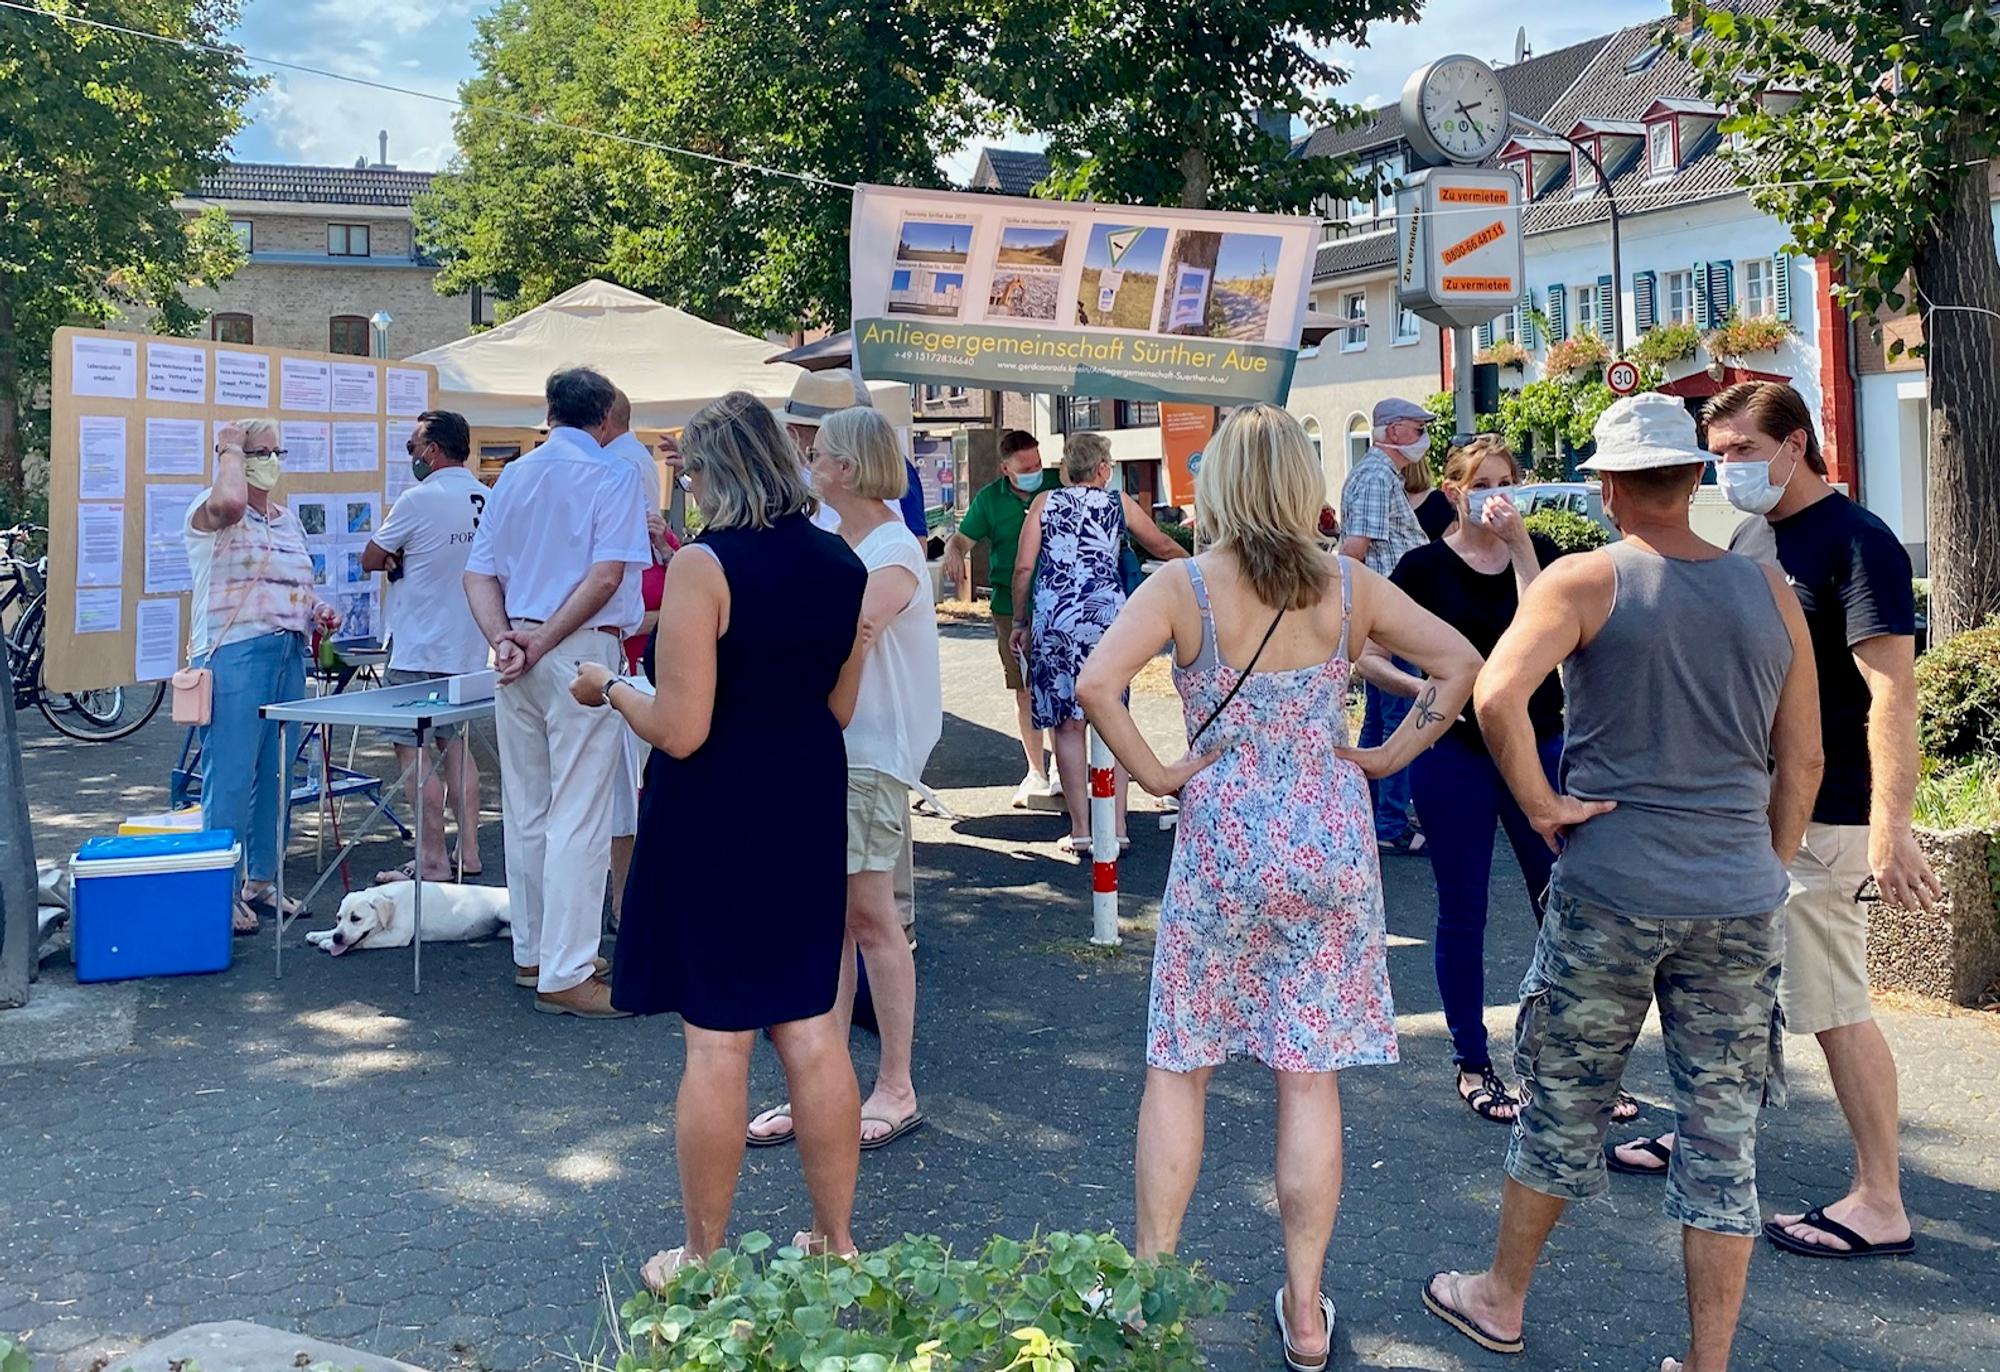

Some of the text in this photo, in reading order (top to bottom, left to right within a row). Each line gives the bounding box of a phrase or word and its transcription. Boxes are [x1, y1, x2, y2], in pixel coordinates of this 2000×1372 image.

[1442, 189, 1506, 202] Zu vermieten
[1403, 207, 1420, 283] Zu vermieten
[1446, 279, 1509, 289] Zu vermieten
[863, 321, 1268, 373] Anliegergemeinschaft Sürther Aue
[894, 351, 912, 360] +49
[1614, 370, 1632, 385] 30
